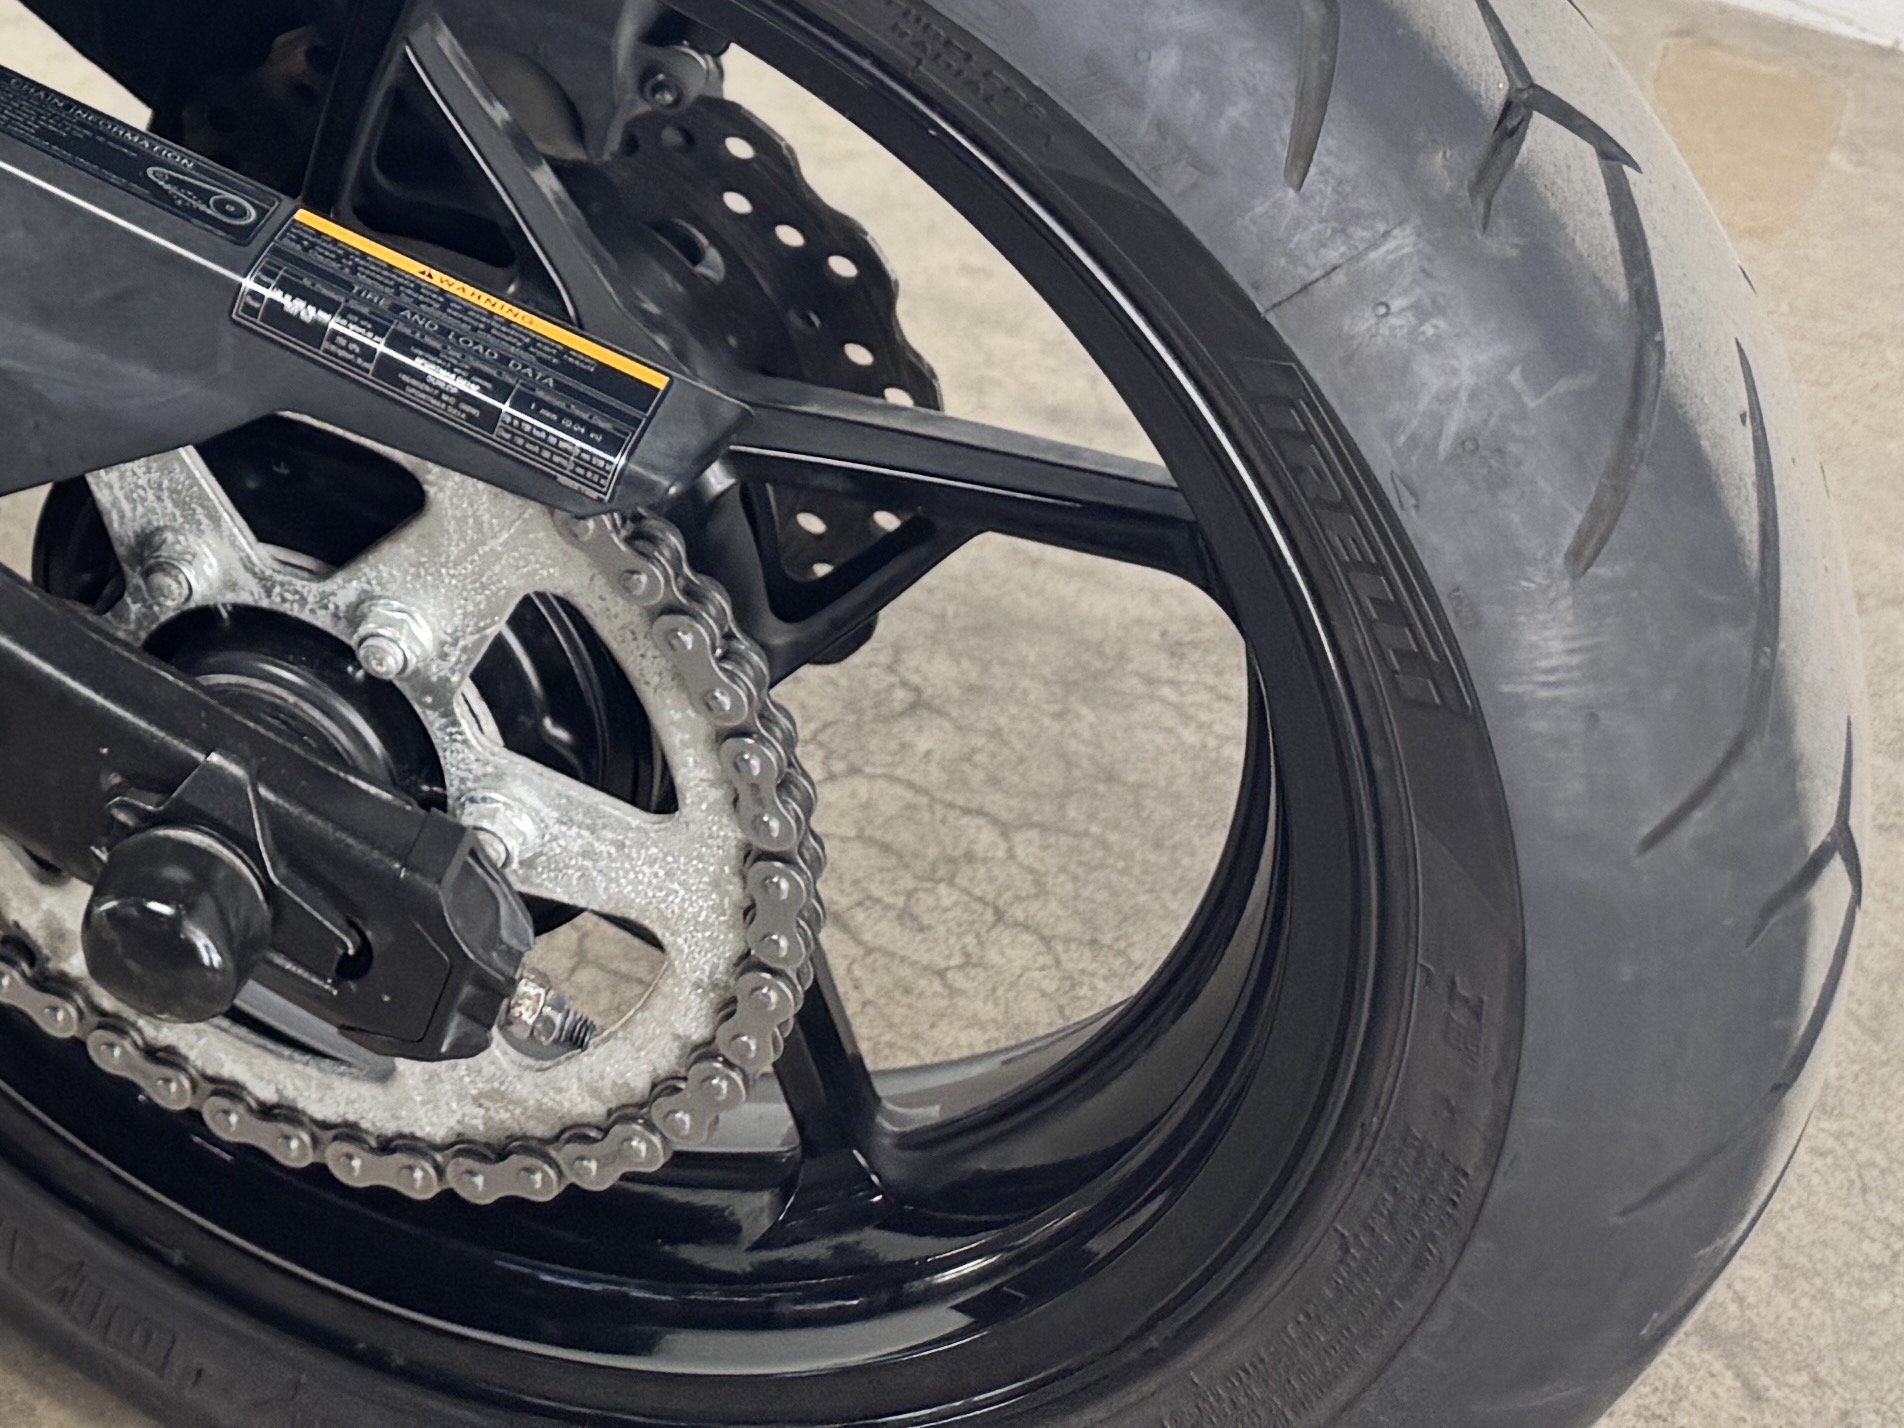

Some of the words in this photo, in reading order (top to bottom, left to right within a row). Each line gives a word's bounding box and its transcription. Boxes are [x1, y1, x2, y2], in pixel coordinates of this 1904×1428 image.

[70, 104, 194, 169] INFORMATION
[439, 276, 536, 327] WARNING
[399, 309, 441, 332] AND
[447, 332, 499, 361] LOAD
[508, 358, 555, 389] DATA
